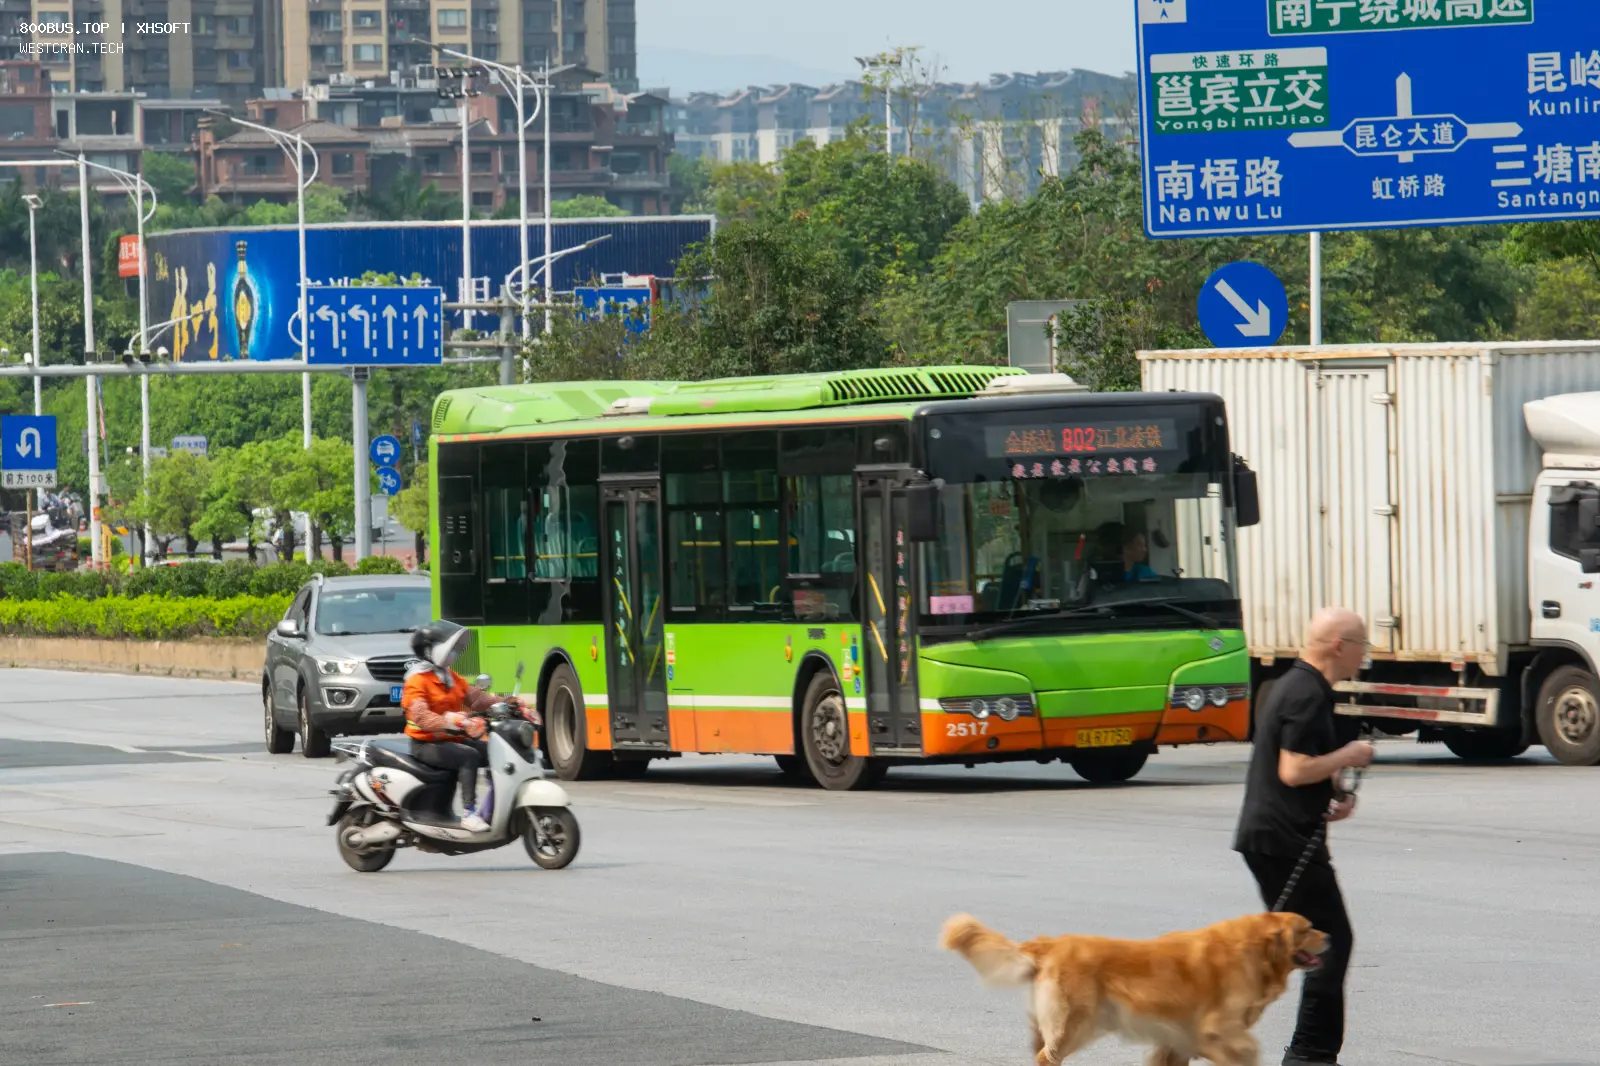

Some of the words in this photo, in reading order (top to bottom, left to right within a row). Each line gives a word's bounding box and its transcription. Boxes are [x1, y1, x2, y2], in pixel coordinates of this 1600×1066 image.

[1192, 53, 1280, 69] 快速环路
[1155, 69, 1325, 118] 邕宾立交
[1355, 121, 1455, 149] 昆仑大道
[1490, 140, 1600, 188] 三塘南
[1153, 156, 1284, 203] 南梧路
[1371, 173, 1447, 200] 虹桥路
[1062, 427, 1097, 452] 802
[5, 473, 54, 485] 前方100米
[945, 721, 989, 737] 2517
